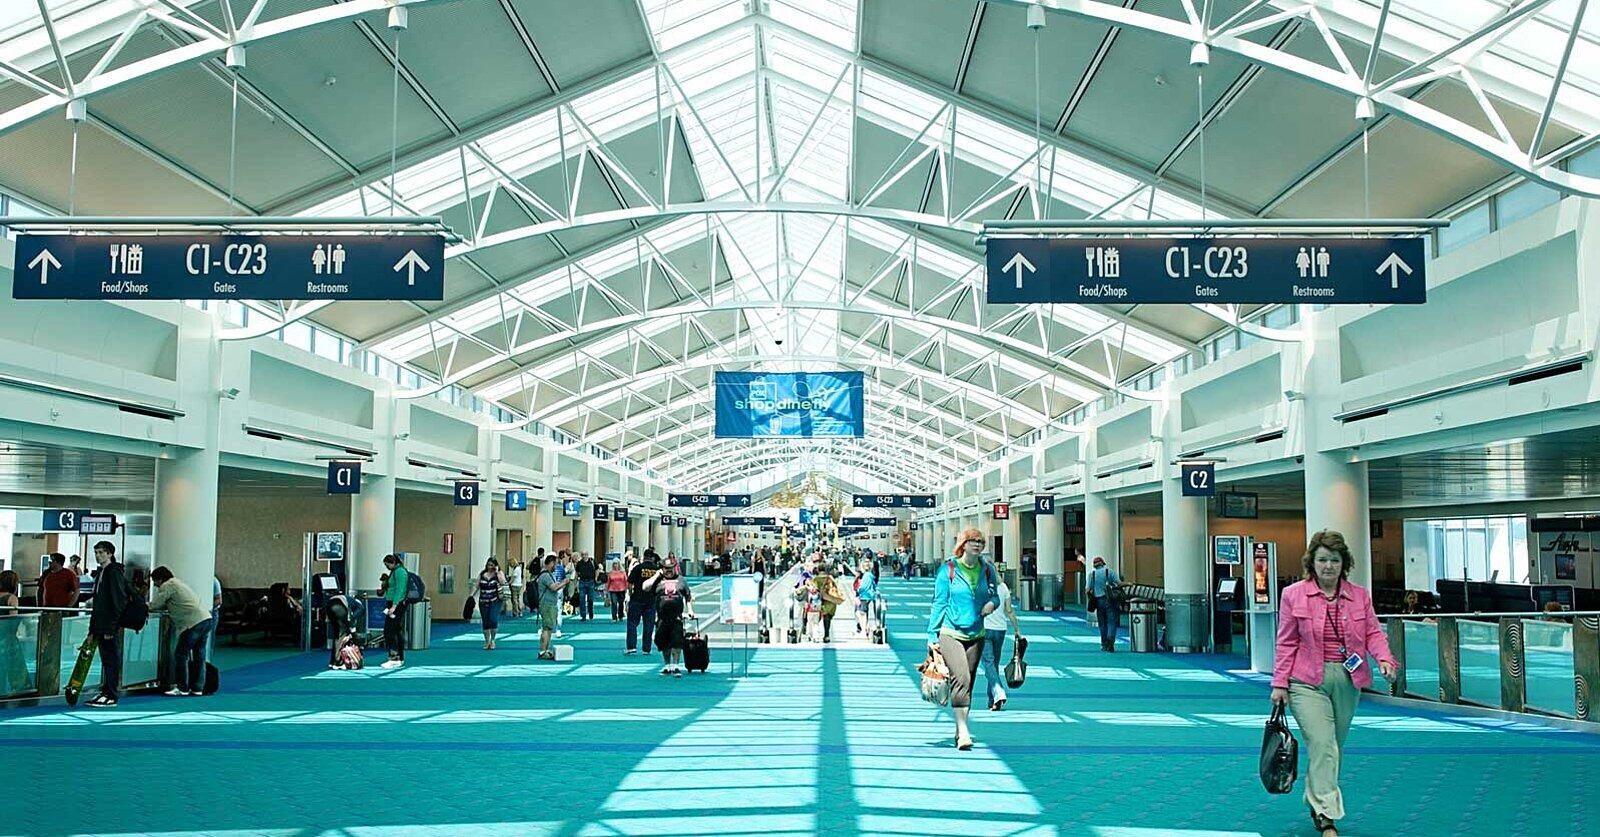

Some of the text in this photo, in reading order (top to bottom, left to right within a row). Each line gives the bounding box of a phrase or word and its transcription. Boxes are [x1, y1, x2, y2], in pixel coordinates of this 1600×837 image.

[186, 243, 267, 275] C1-C23
[1165, 246, 1248, 278] C1-C23
[101, 282, 148, 294] Food/Shops
[213, 281, 236, 293] Gates
[307, 282, 348, 293] Restrooms
[1079, 285, 1127, 297] Food/Shops
[1195, 285, 1218, 297] Gates
[1293, 286, 1335, 297] Restrooms
[336, 468, 352, 486] C1
[1189, 470, 1208, 489] C2
[459, 485, 473, 500] C3
[1039, 498, 1051, 511] C4
[59, 511, 75, 529] C3
